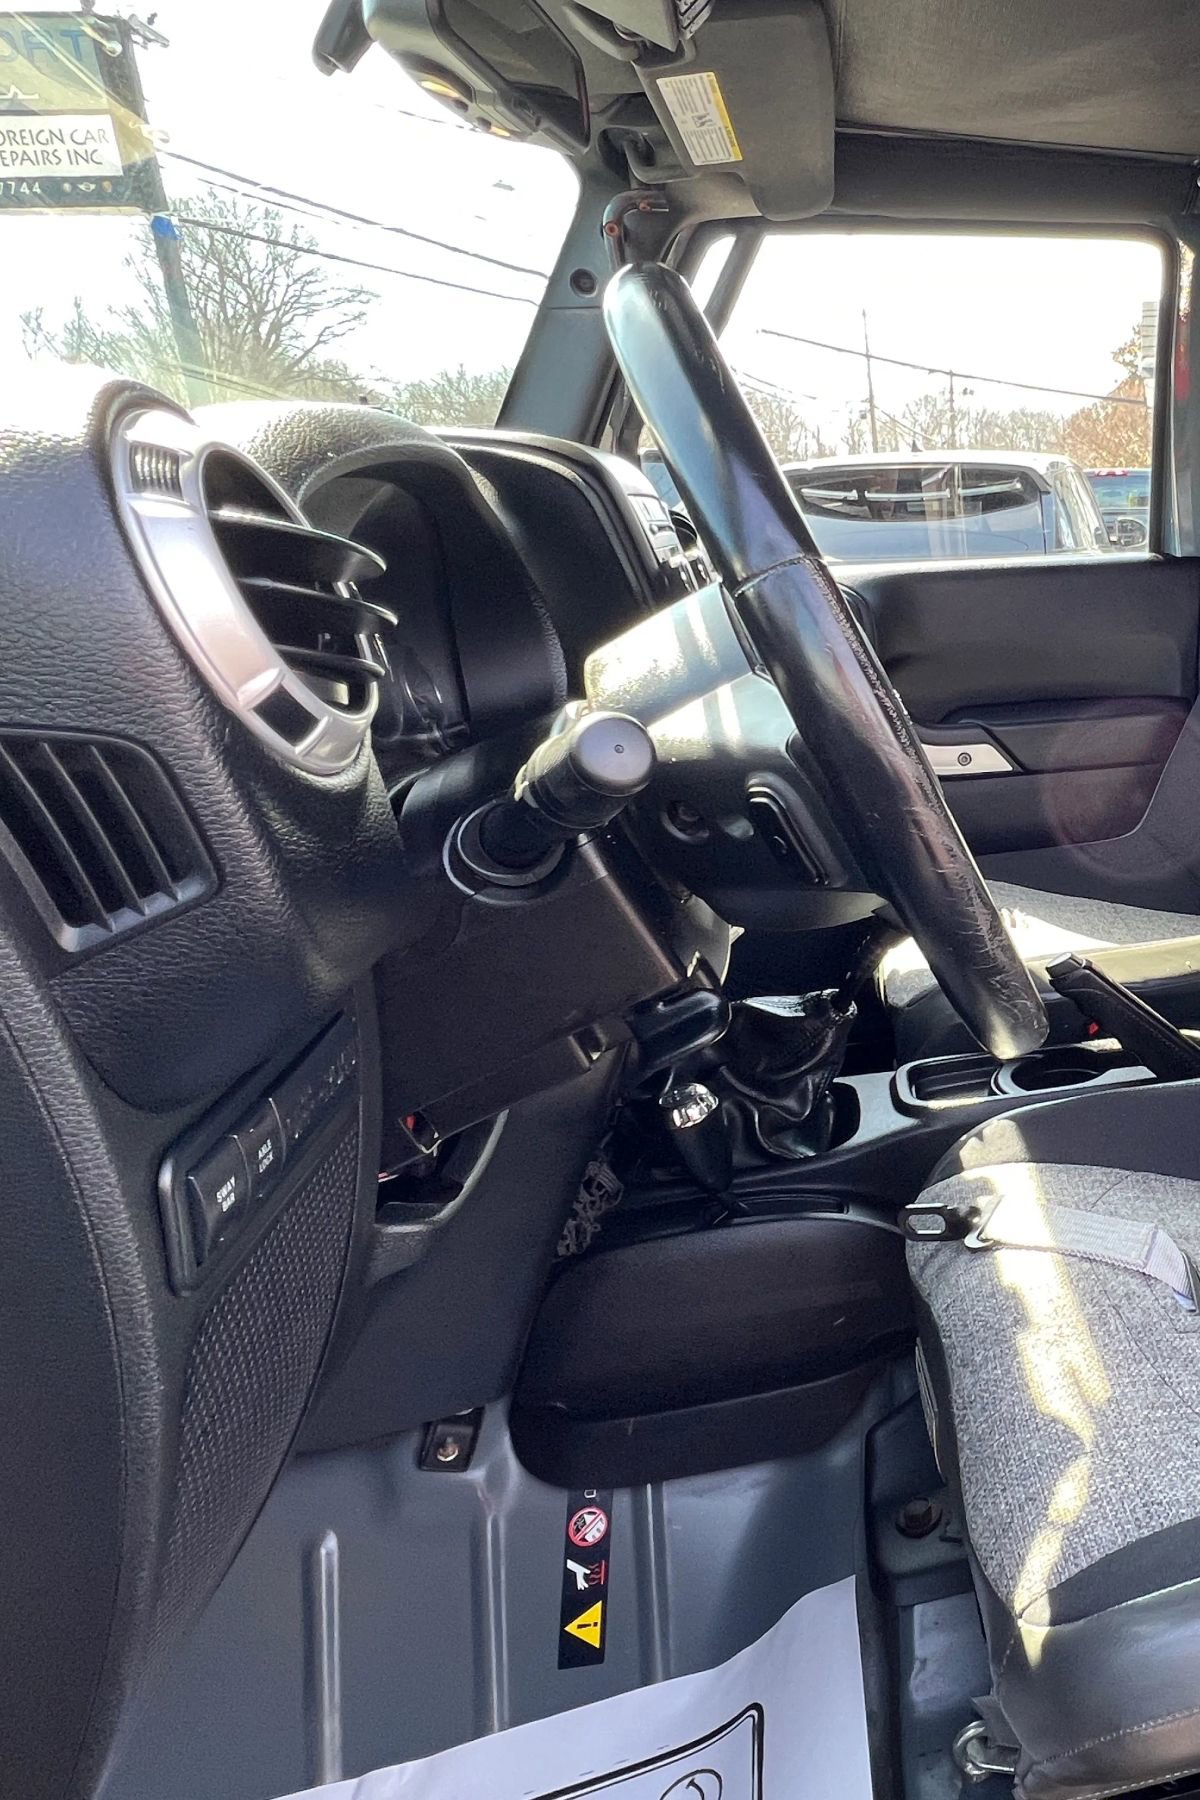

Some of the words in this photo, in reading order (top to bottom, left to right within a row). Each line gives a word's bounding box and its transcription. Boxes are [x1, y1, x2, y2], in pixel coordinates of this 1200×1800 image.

[70, 128, 109, 146] CAR
[66, 149, 103, 166] INC
[216, 1175, 236, 1203] SWAY
[221, 1192, 236, 1213] BAR
